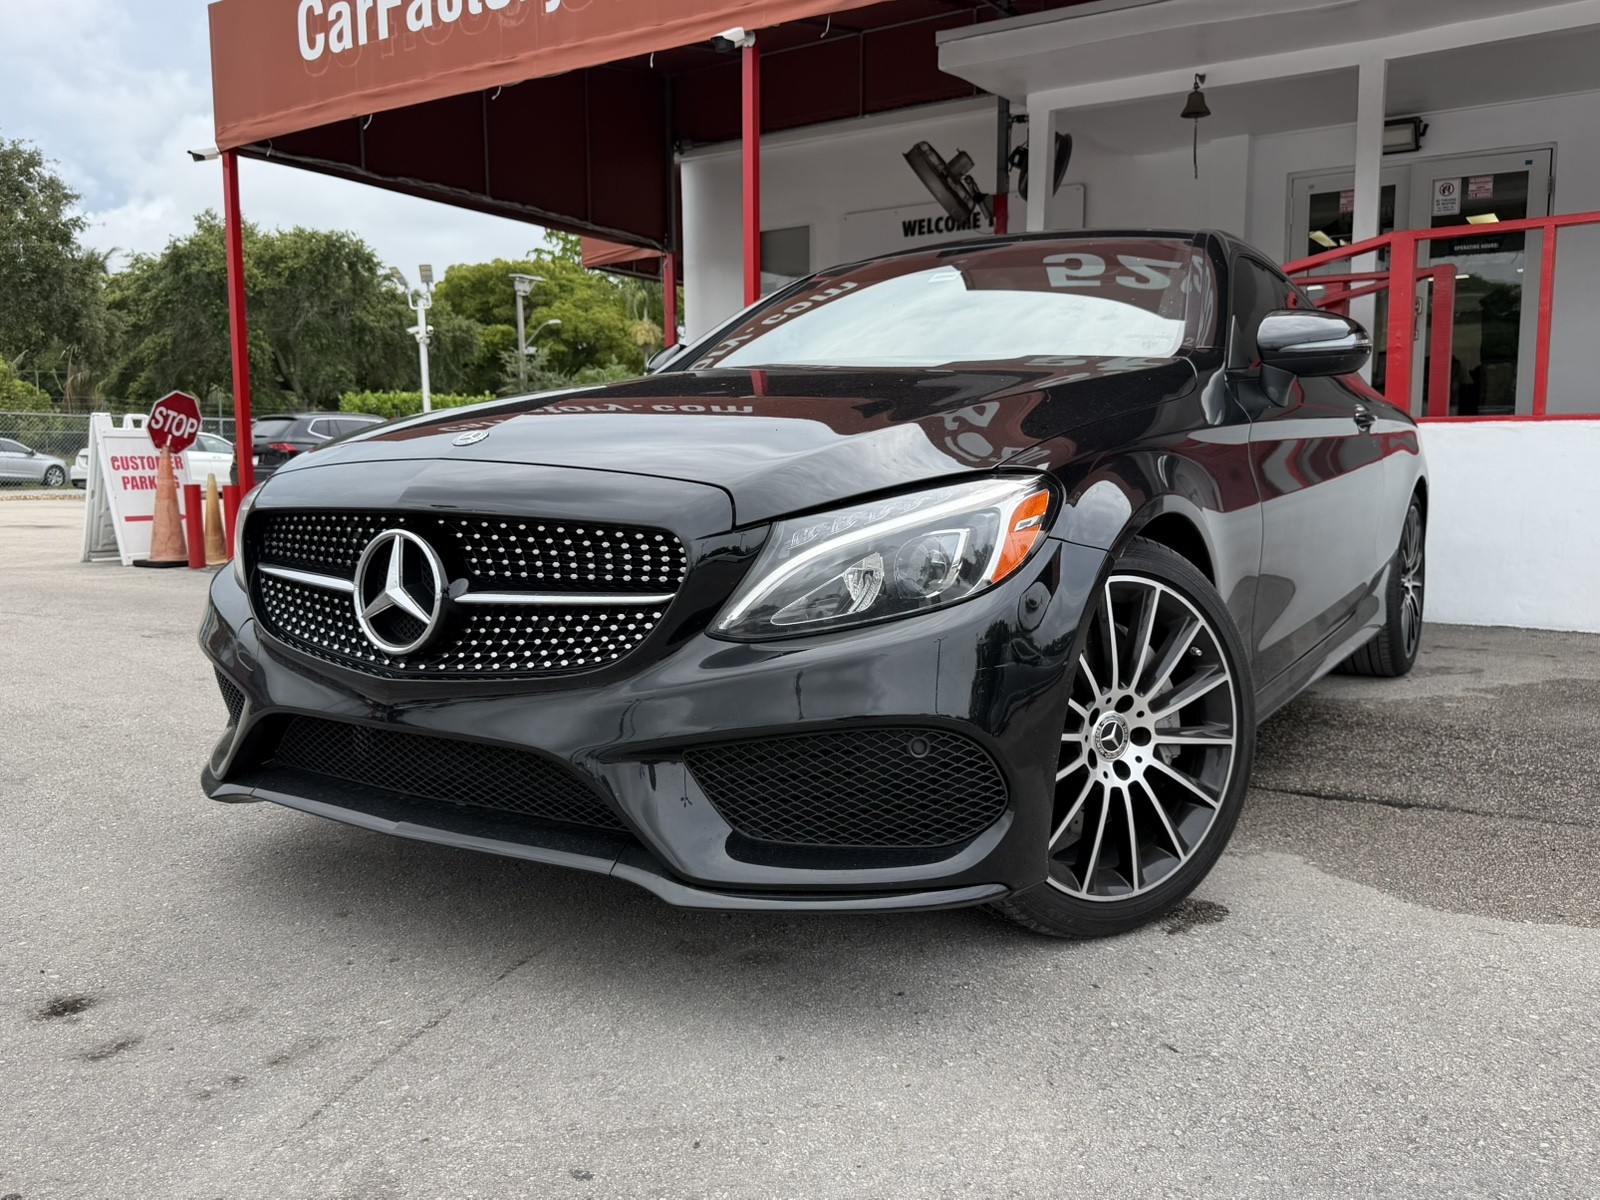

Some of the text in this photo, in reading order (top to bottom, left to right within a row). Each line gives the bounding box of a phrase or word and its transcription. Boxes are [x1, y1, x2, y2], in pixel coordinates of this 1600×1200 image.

[151, 406, 198, 439] STOP
[111, 456, 184, 471] CUSTOR
[122, 475, 180, 490] PARKG
